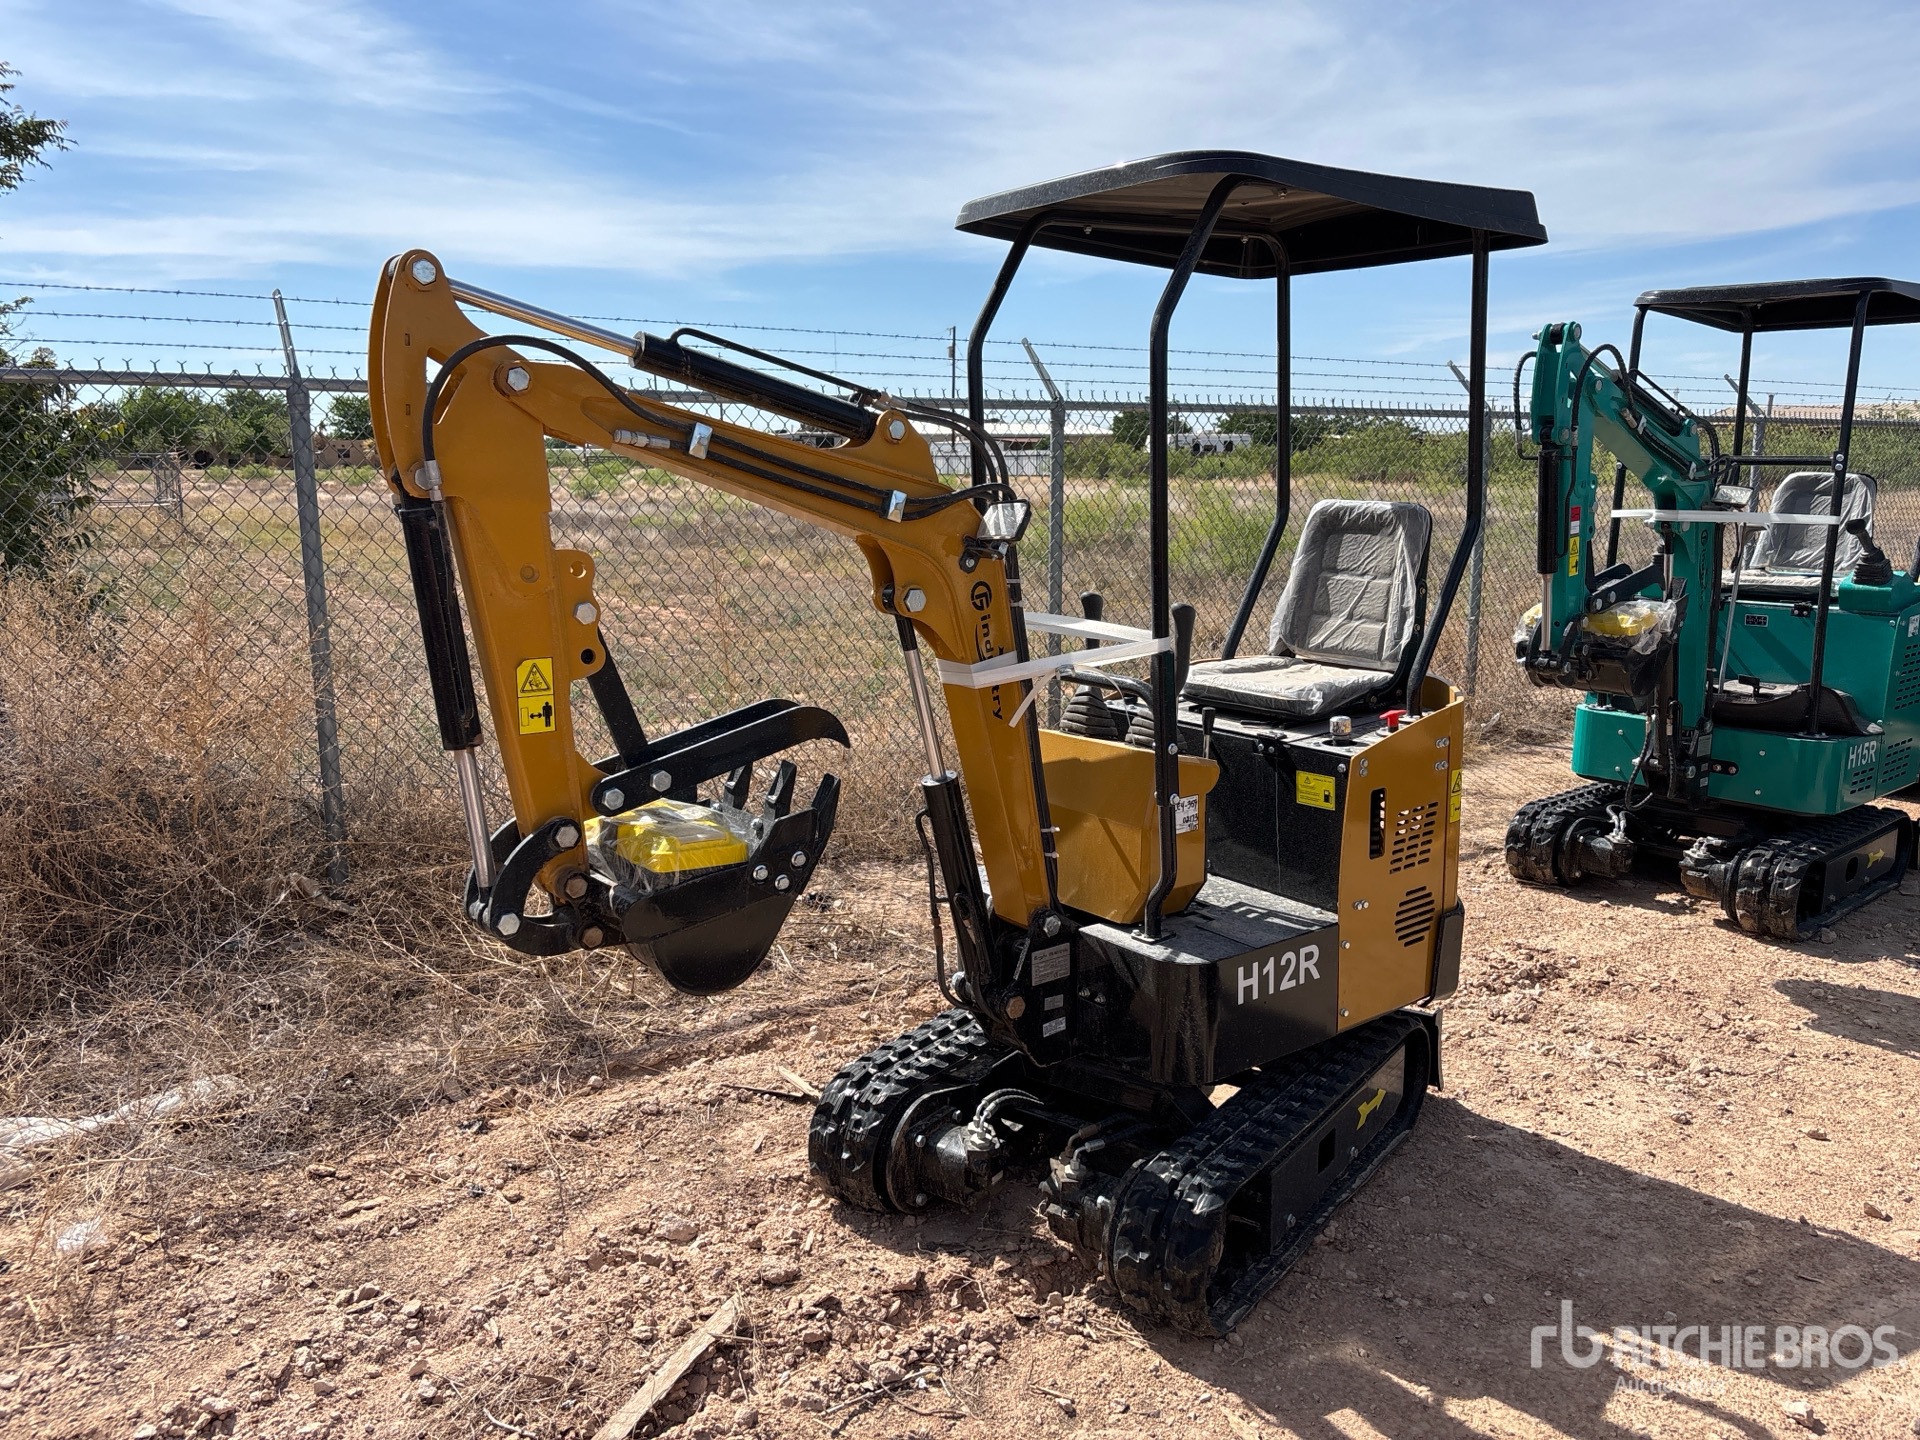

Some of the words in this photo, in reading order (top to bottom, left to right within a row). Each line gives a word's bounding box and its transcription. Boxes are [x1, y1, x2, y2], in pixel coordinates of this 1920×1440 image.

[971, 581, 1003, 720] Gindtry
[1847, 740, 1877, 770] H15R
[1237, 944, 1321, 1005] H12R
